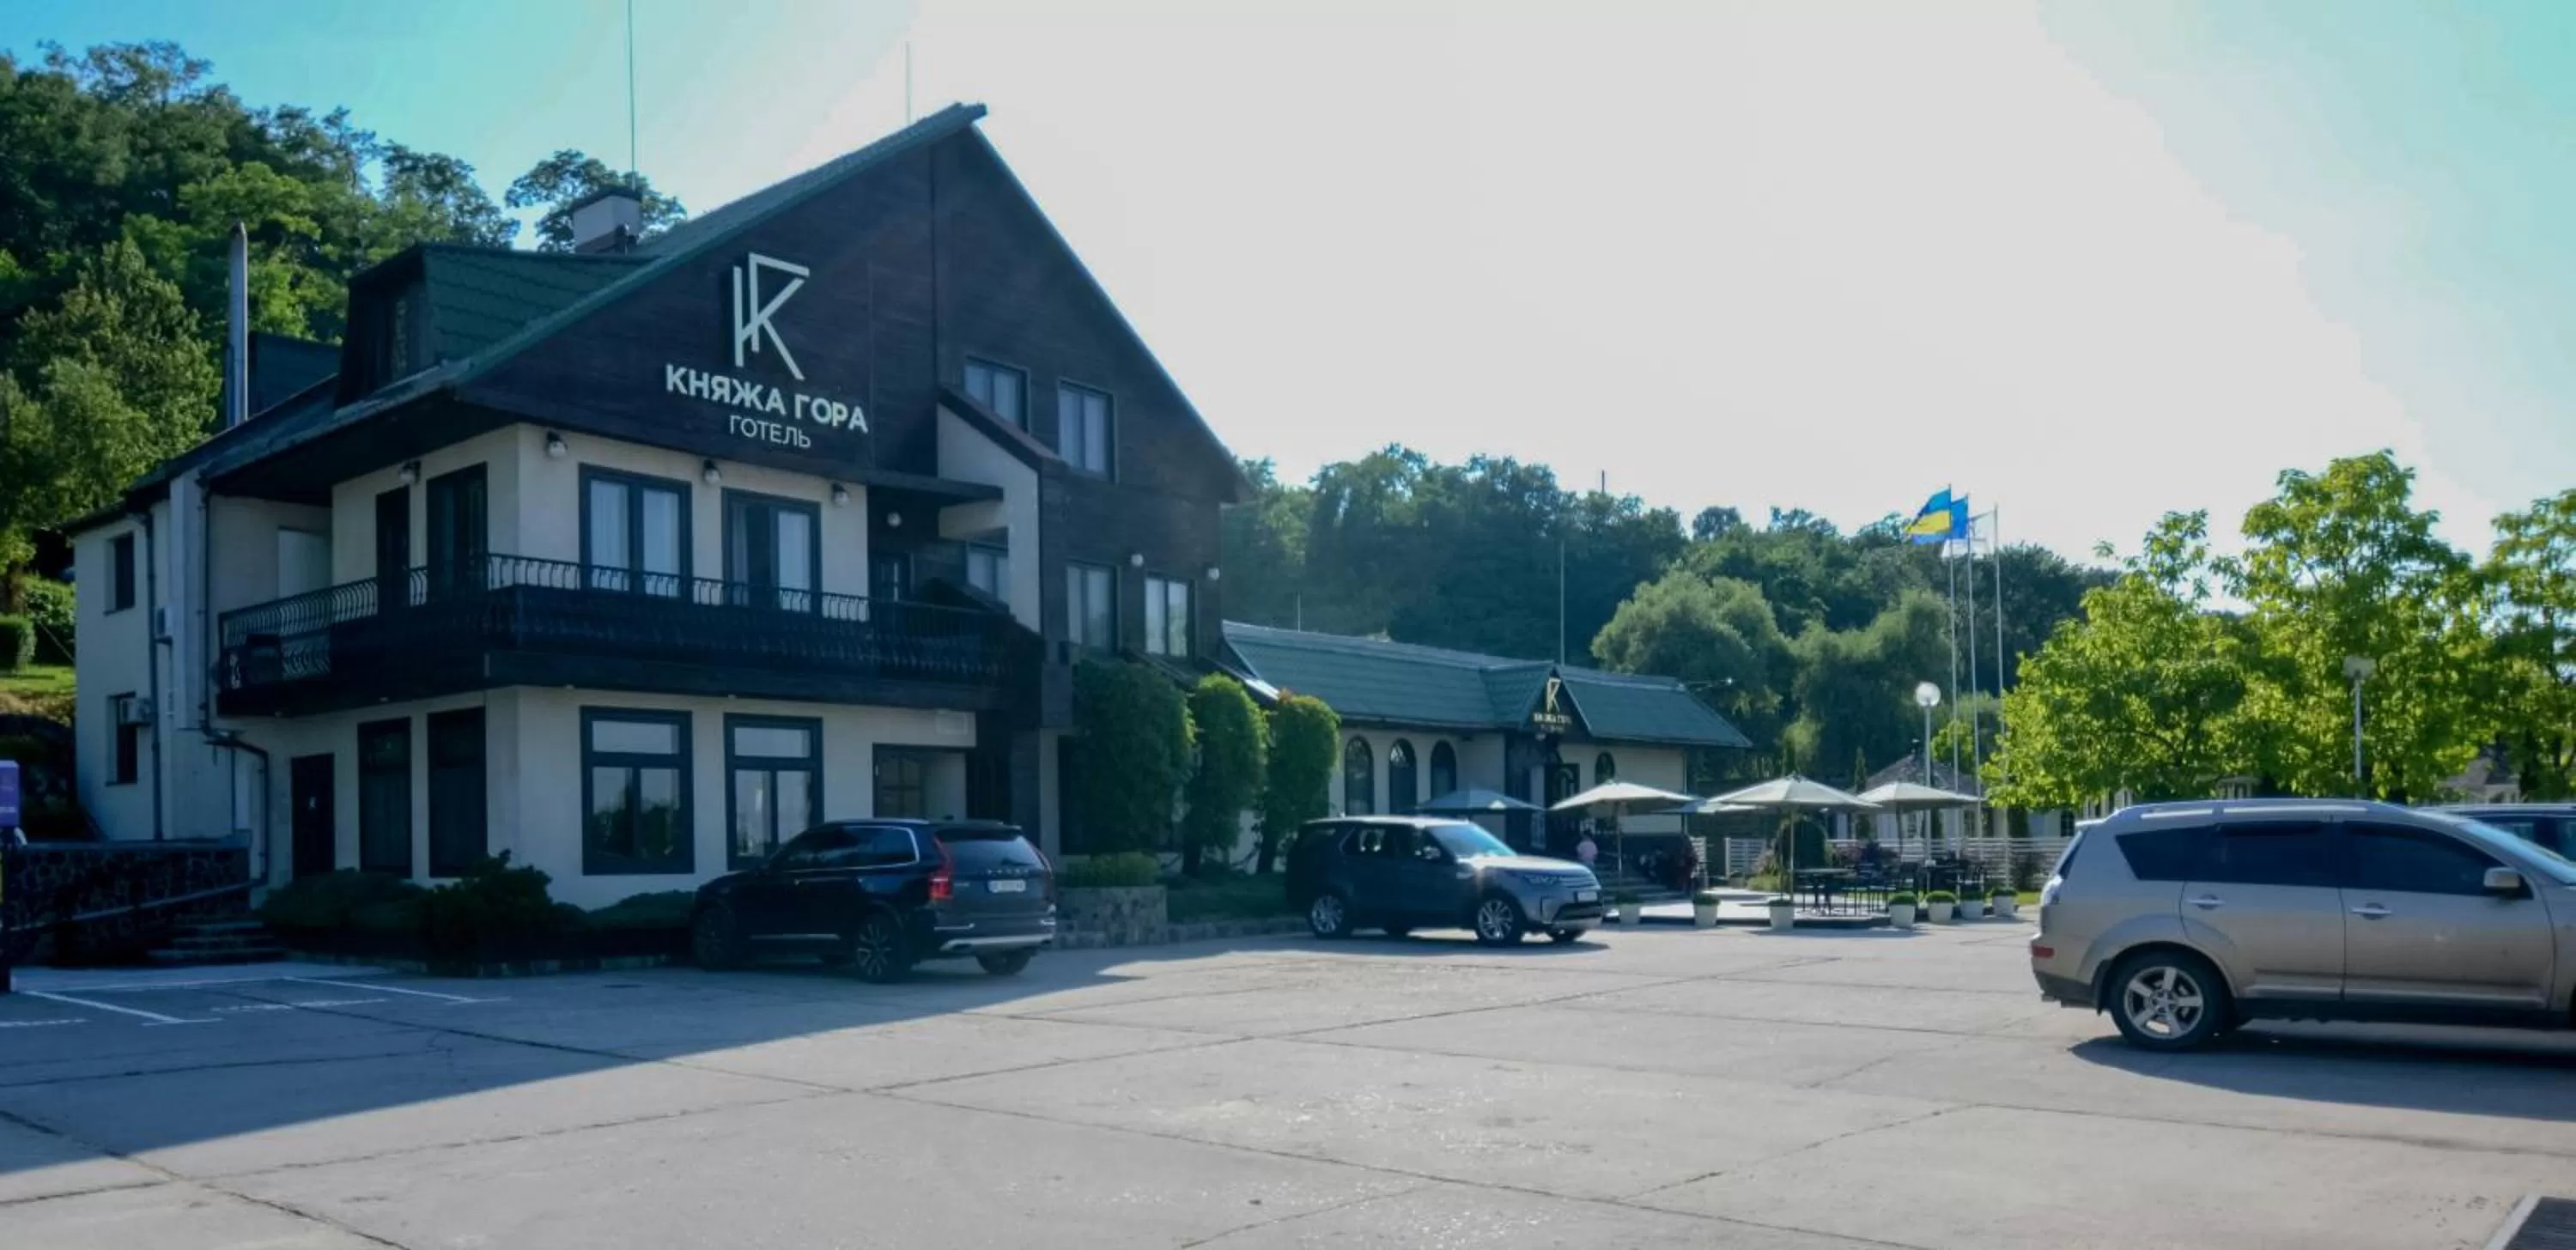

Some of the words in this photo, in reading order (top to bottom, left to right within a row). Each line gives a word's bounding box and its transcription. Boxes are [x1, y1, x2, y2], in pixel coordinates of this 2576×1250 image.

[665, 363, 787, 416] КНЯЖА
[794, 393, 869, 434] ГОРА
[730, 415, 811, 448] ГОТЕЛЬ
